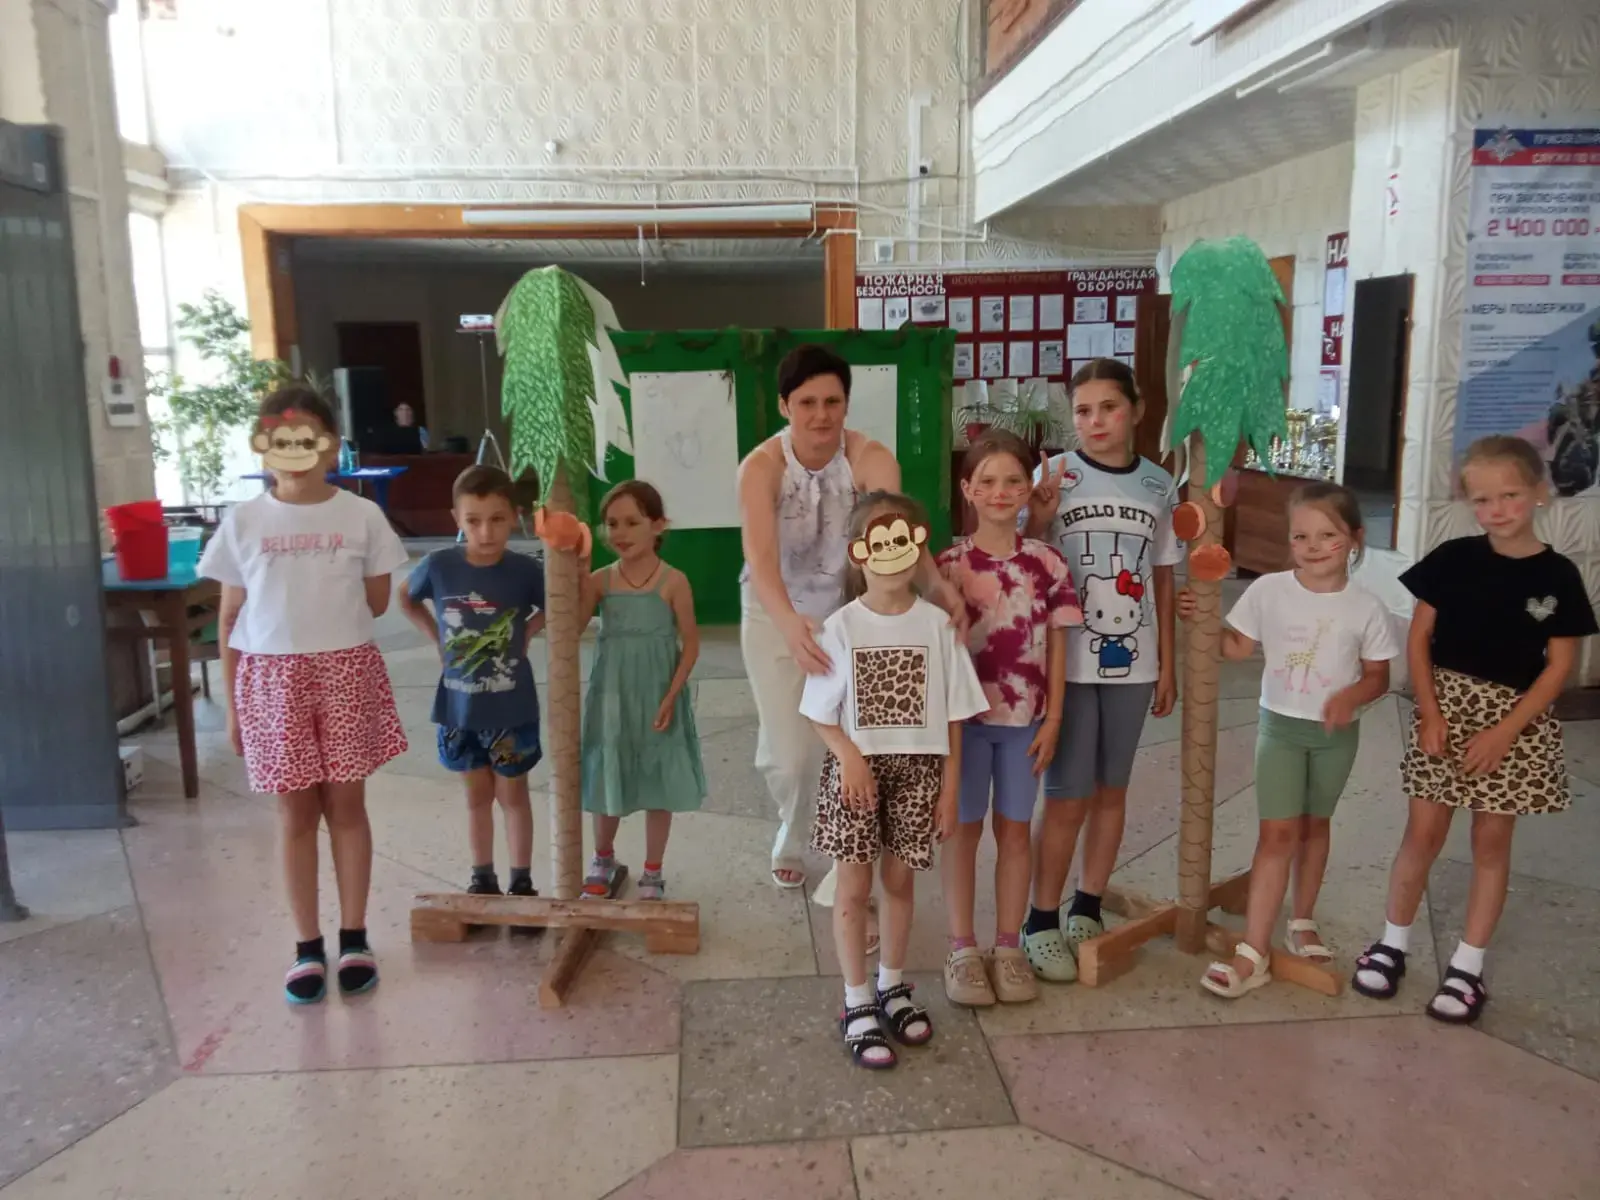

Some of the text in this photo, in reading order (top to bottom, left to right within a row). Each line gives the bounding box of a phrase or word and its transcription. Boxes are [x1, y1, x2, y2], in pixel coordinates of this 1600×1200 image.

[1487, 217, 1589, 237] 2 400 000
[864, 272, 943, 286] ПОЖАРНАЯ
[1067, 268, 1156, 282] ГРАЖДАНСКАЯ
[856, 284, 946, 297] БЕЗОПАСНОСТЬ
[1077, 280, 1144, 292] ОБОРОНА
[1472, 303, 1585, 315] МЕРЫ ПОДДЕРЖКИ
[1062, 504, 1115, 528] HELLO
